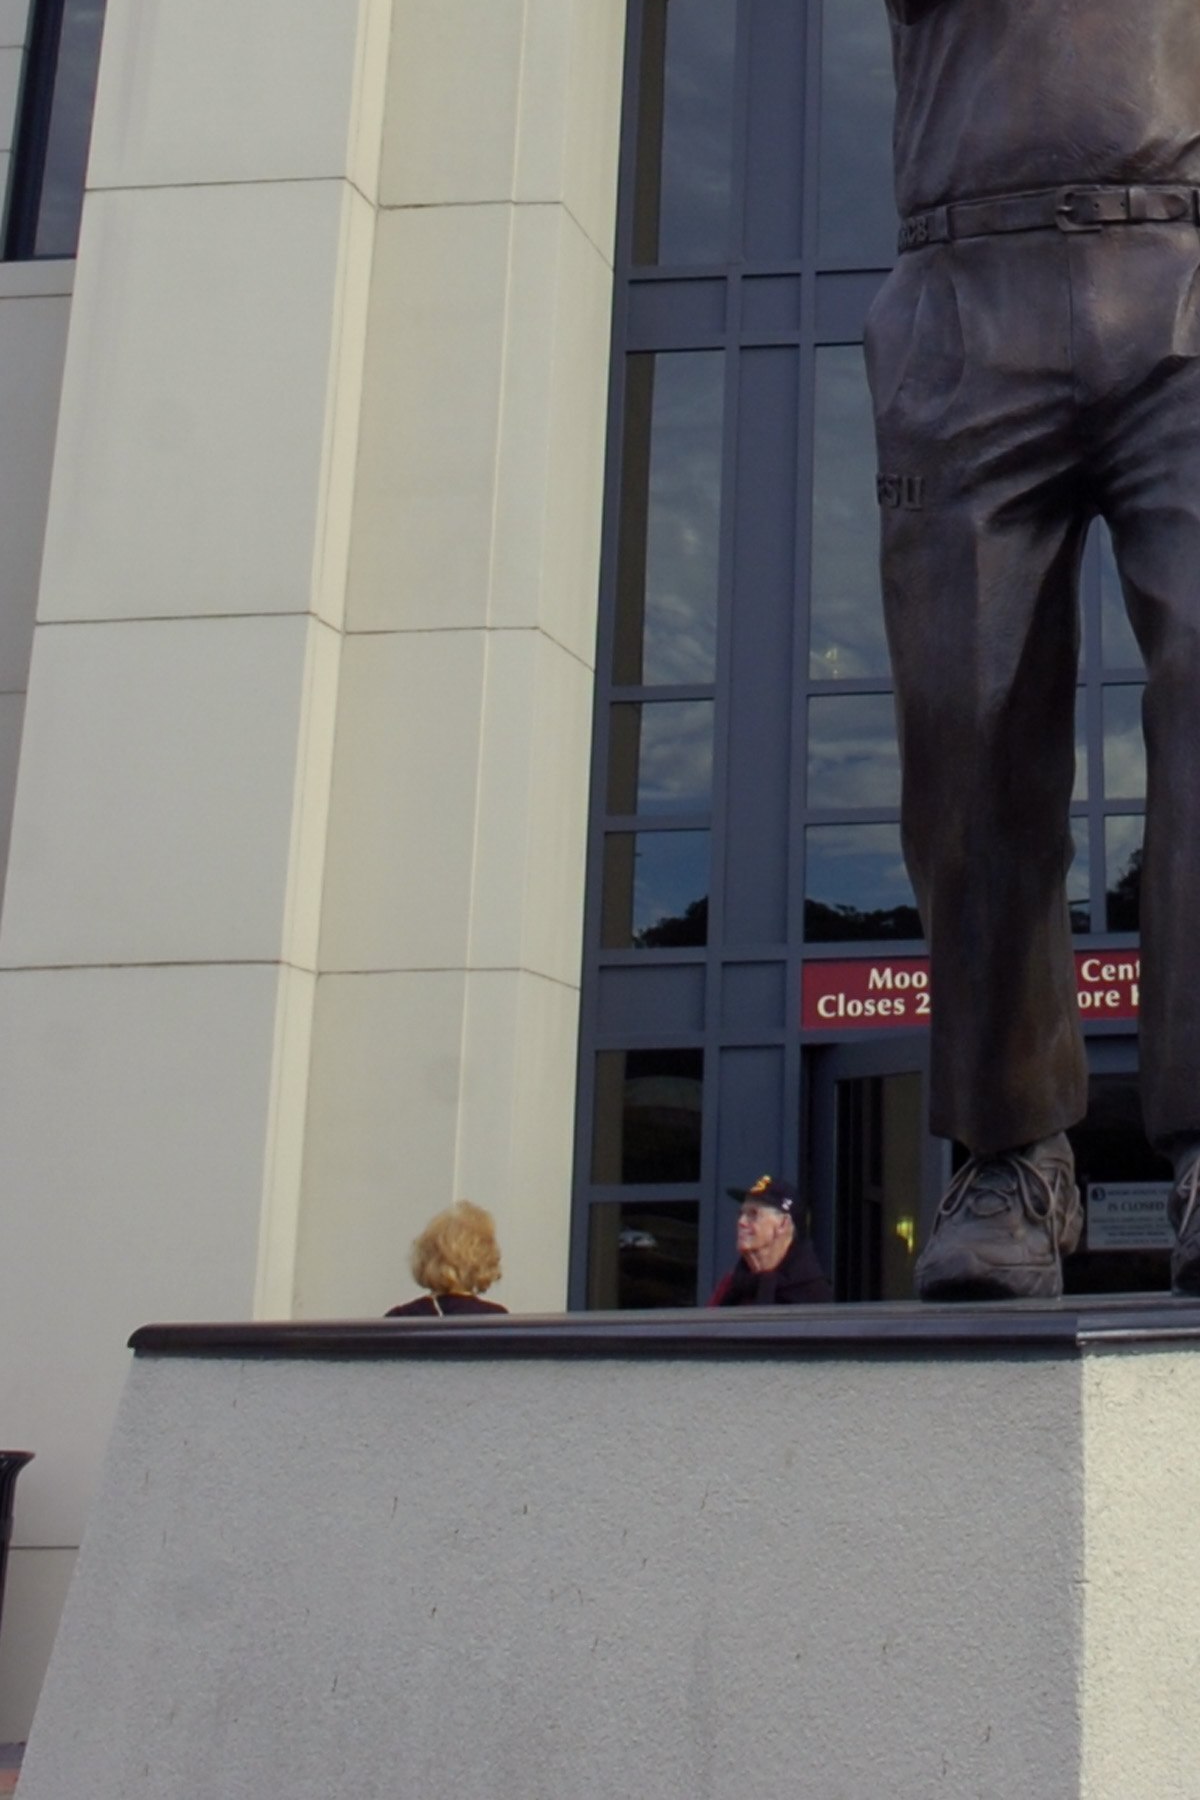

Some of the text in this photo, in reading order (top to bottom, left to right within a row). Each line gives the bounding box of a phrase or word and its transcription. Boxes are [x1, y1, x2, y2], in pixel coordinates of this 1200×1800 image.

[868, 958, 1140, 990] Moo Cent
[816, 992, 906, 1018] Closes
[915, 992, 931, 1015] 2
[1077, 990, 1121, 1009] ore
[1121, 1201, 1165, 1212] CLOSED
